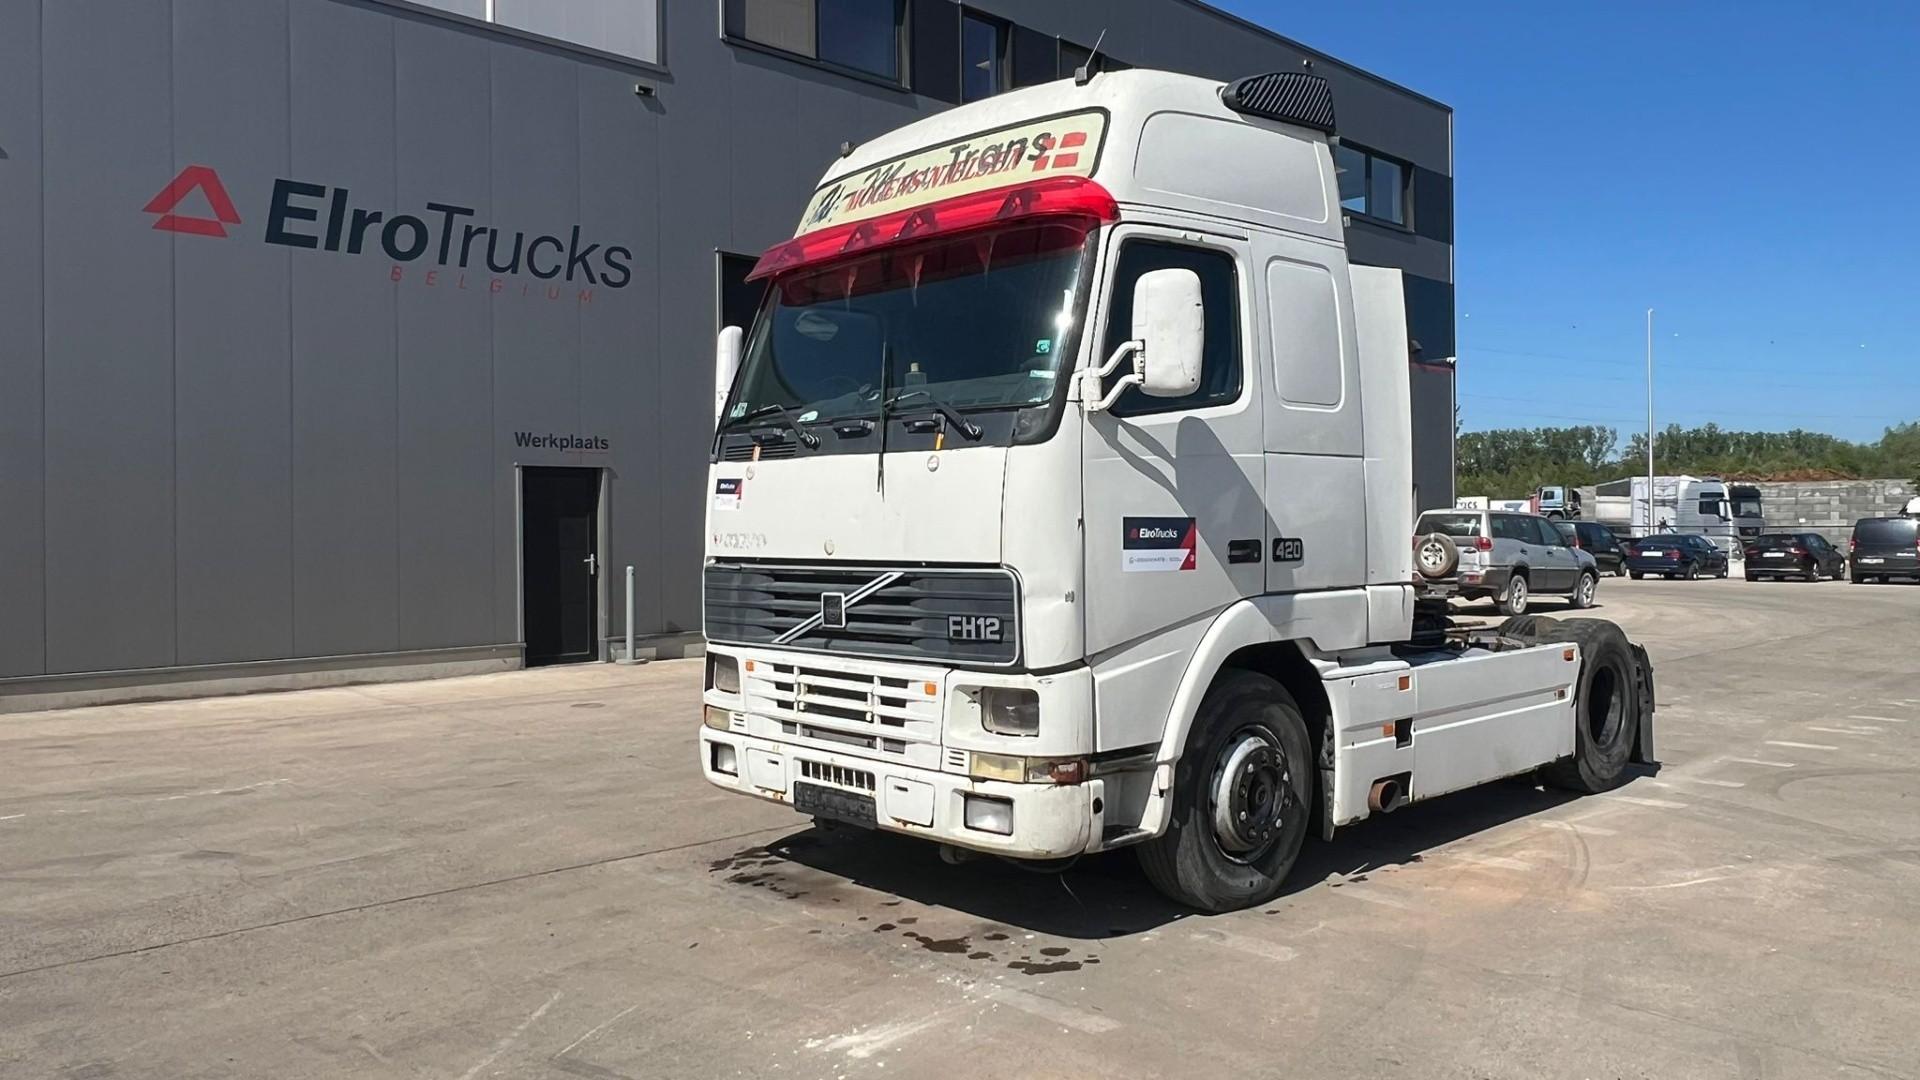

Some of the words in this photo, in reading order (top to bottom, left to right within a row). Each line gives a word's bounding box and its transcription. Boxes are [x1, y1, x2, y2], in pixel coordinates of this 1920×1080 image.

[264, 178, 632, 289] ElroTrucks
[389, 265, 594, 303] BELGIUM
[514, 431, 609, 452] Werkplaats
[1139, 528, 1178, 539] ElroTrucks
[1275, 541, 1302, 560] 420
[948, 615, 1001, 640] FH12
